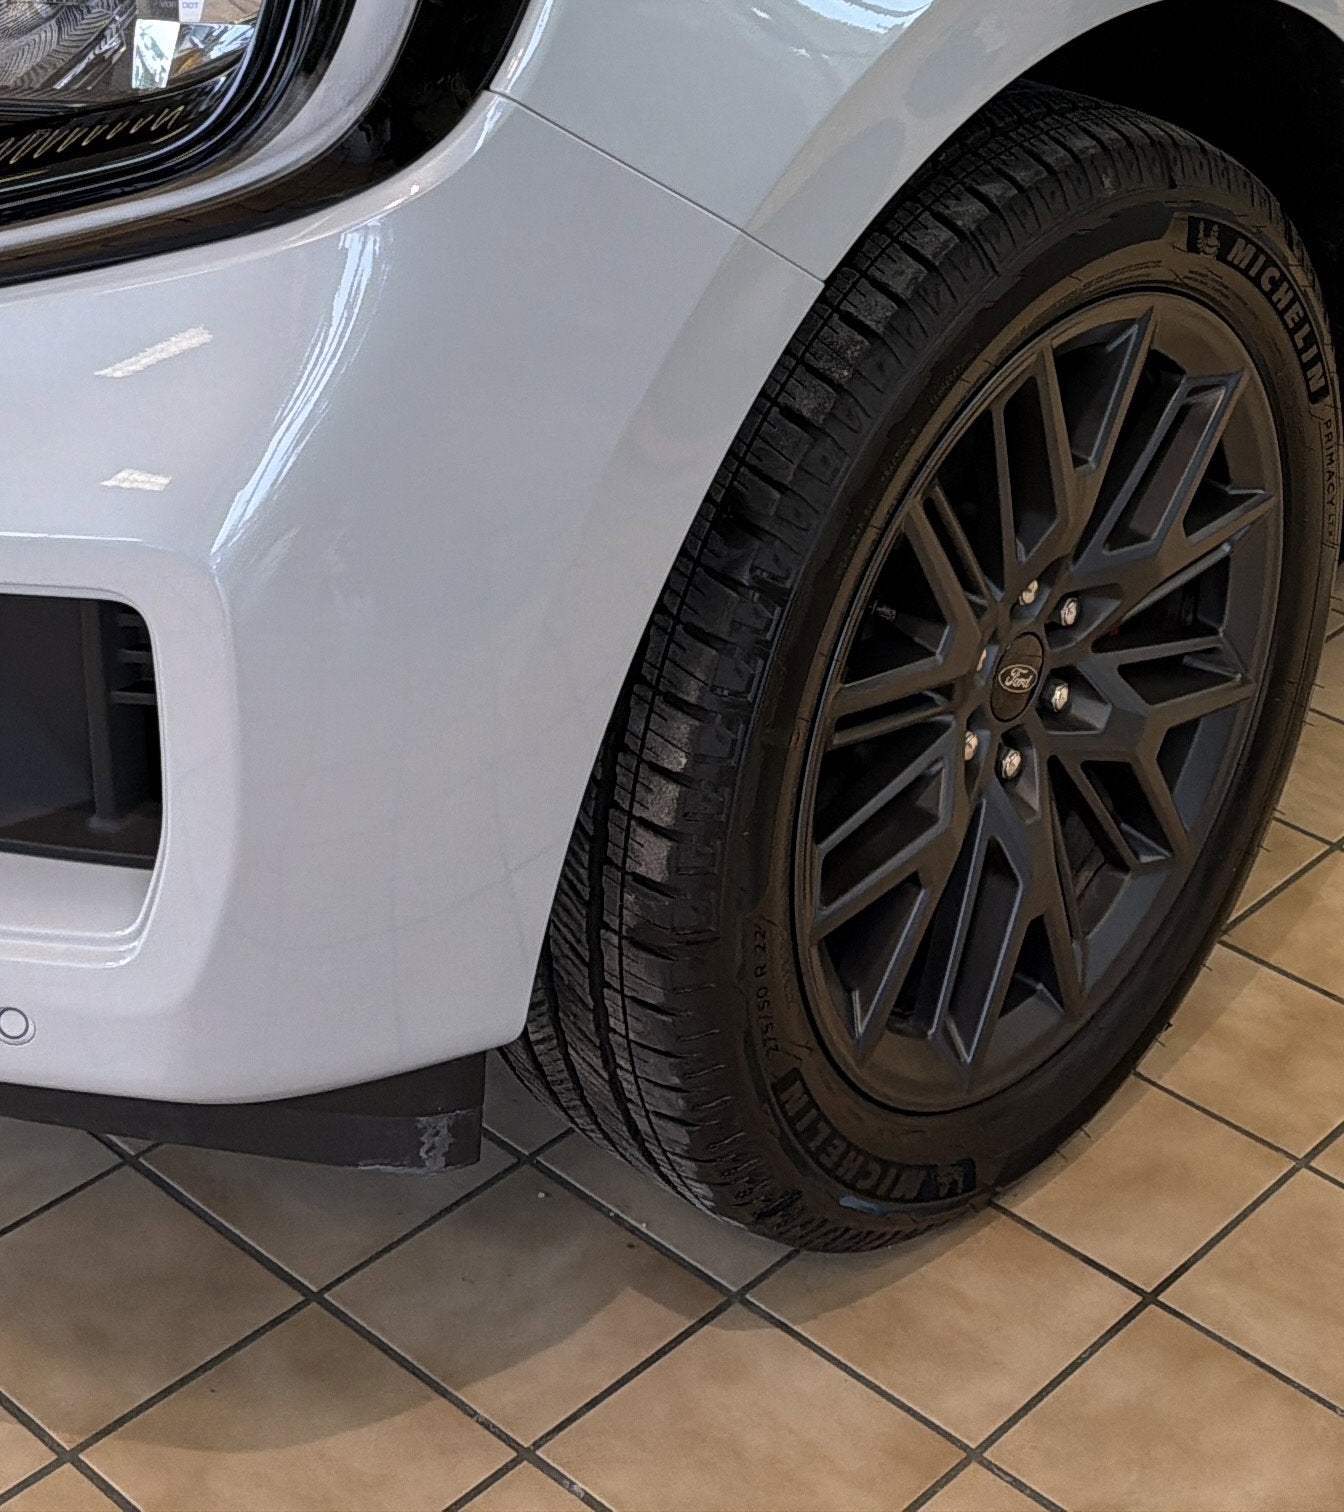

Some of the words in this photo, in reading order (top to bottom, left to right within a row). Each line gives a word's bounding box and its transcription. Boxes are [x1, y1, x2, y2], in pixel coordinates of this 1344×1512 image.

[1226, 237, 1329, 397] MICHELIN
[1321, 418, 1336, 507] PRIMACY
[1004, 667, 1034, 689] Ford
[779, 1078, 927, 1201] MICHELIN
